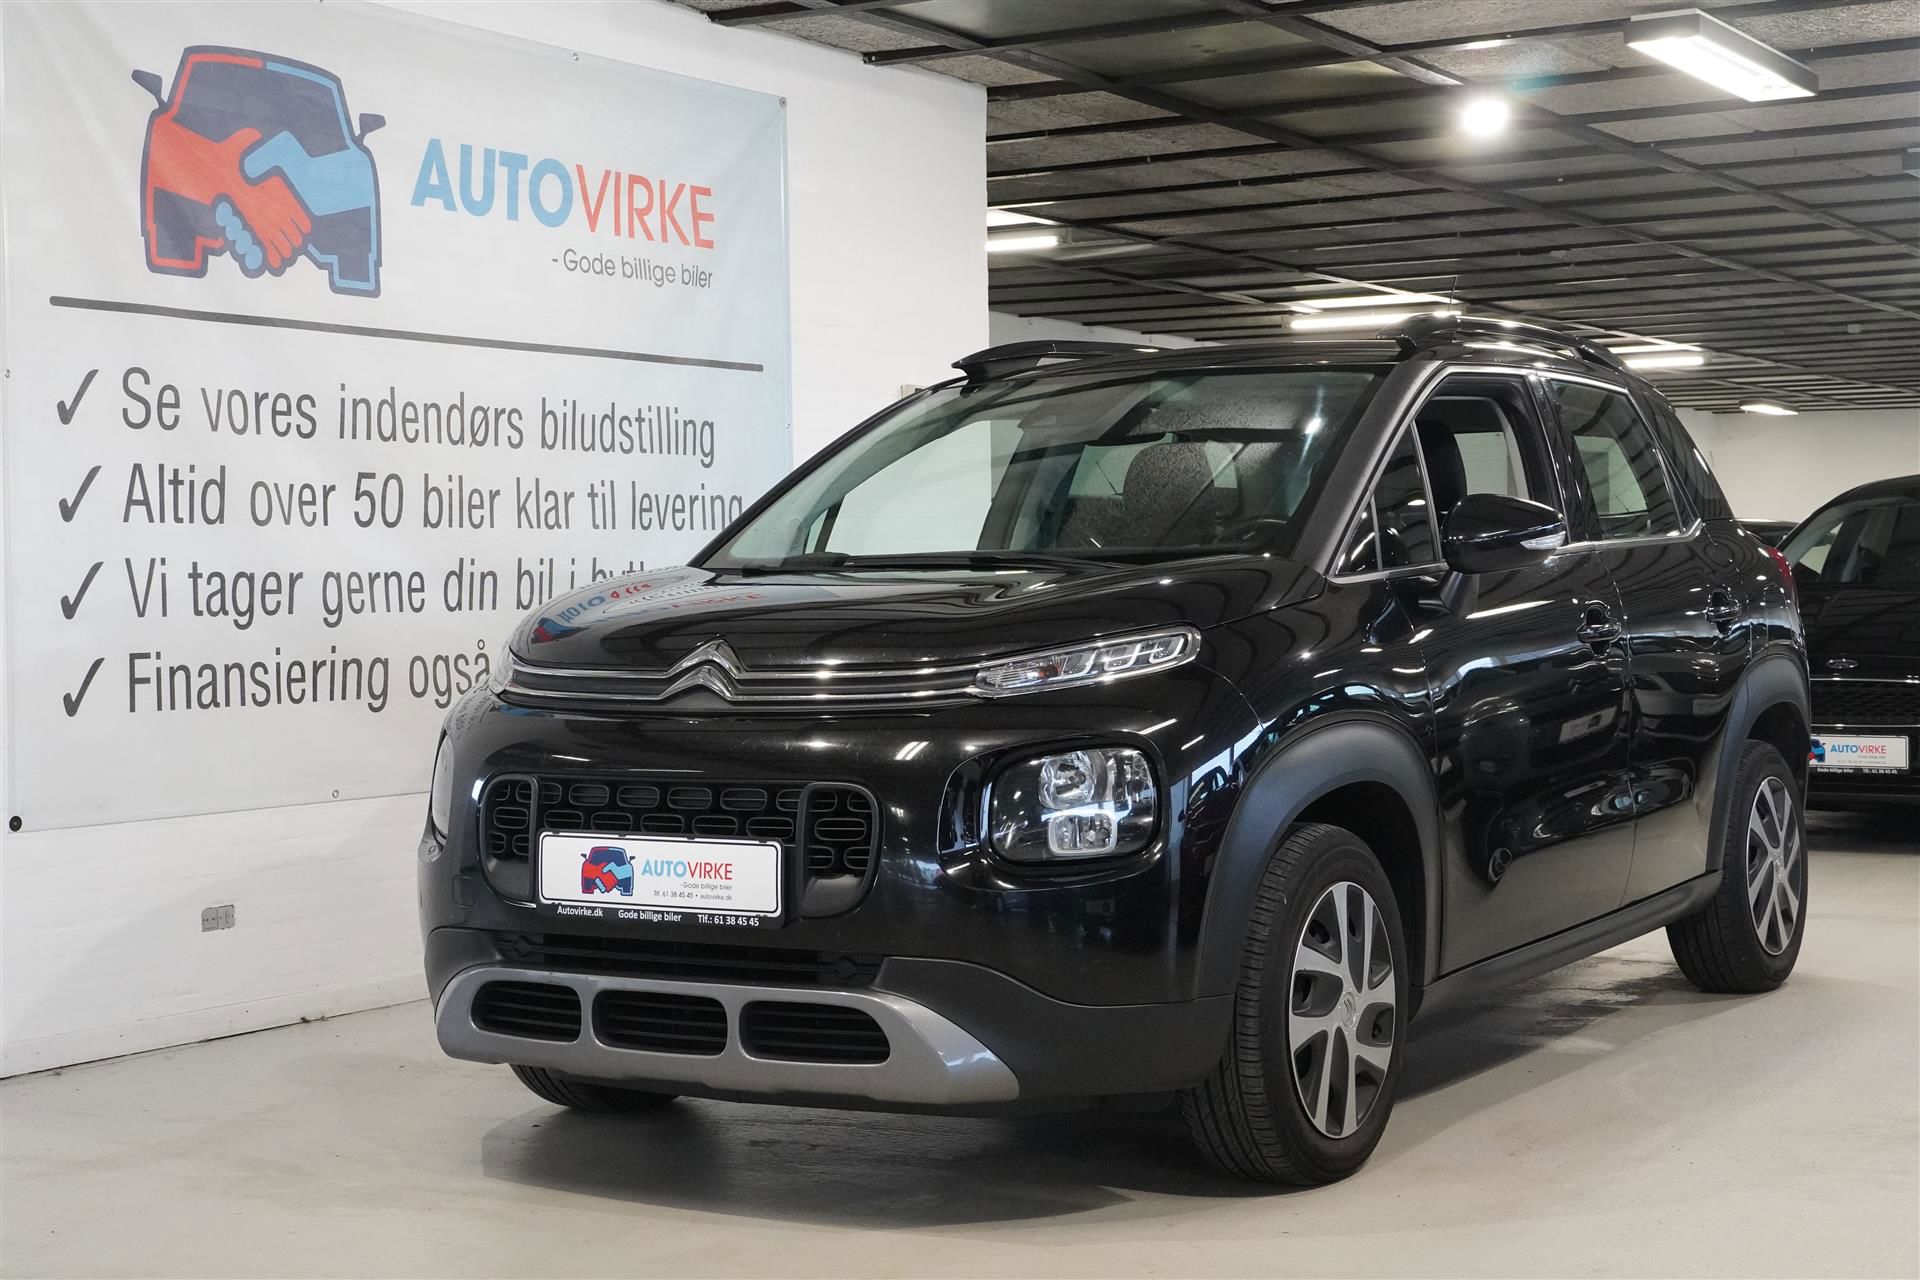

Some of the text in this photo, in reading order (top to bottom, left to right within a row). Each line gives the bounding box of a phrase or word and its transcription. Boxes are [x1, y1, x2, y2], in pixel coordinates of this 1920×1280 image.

[411, 138, 715, 249] AUTOVIRKE
[563, 248, 616, 277] Gode
[621, 255, 676, 288] billige
[681, 263, 713, 288] biler
[122, 366, 715, 469] Se vores indendørs biludstilling
[122, 462, 226, 526] Altid
[250, 480, 336, 527] over
[353, 471, 404, 529] 50
[423, 473, 501, 530] biler
[516, 477, 575, 530] klar
[587, 480, 616, 530] til
[124, 557, 168, 618] Vi
[187, 561, 304, 631] tager
[322, 570, 426, 629] gerne
[443, 557, 498, 613] din
[516, 557, 554, 611] bil
[128, 645, 389, 713] Finansiering
[409, 638, 491, 709] også
[1830, 744, 1887, 754] AUTOVIRKE
[641, 859, 733, 881] AUTOVIRKE
[683, 881, 699, 890] Gode
[700, 882, 718, 892] billige
[662, 890, 669, 898] 61
[678, 891, 686, 899] 45
[557, 905, 759, 927] Autovirke.dk Gode billige biler Tlf.: 61 38 45 45
